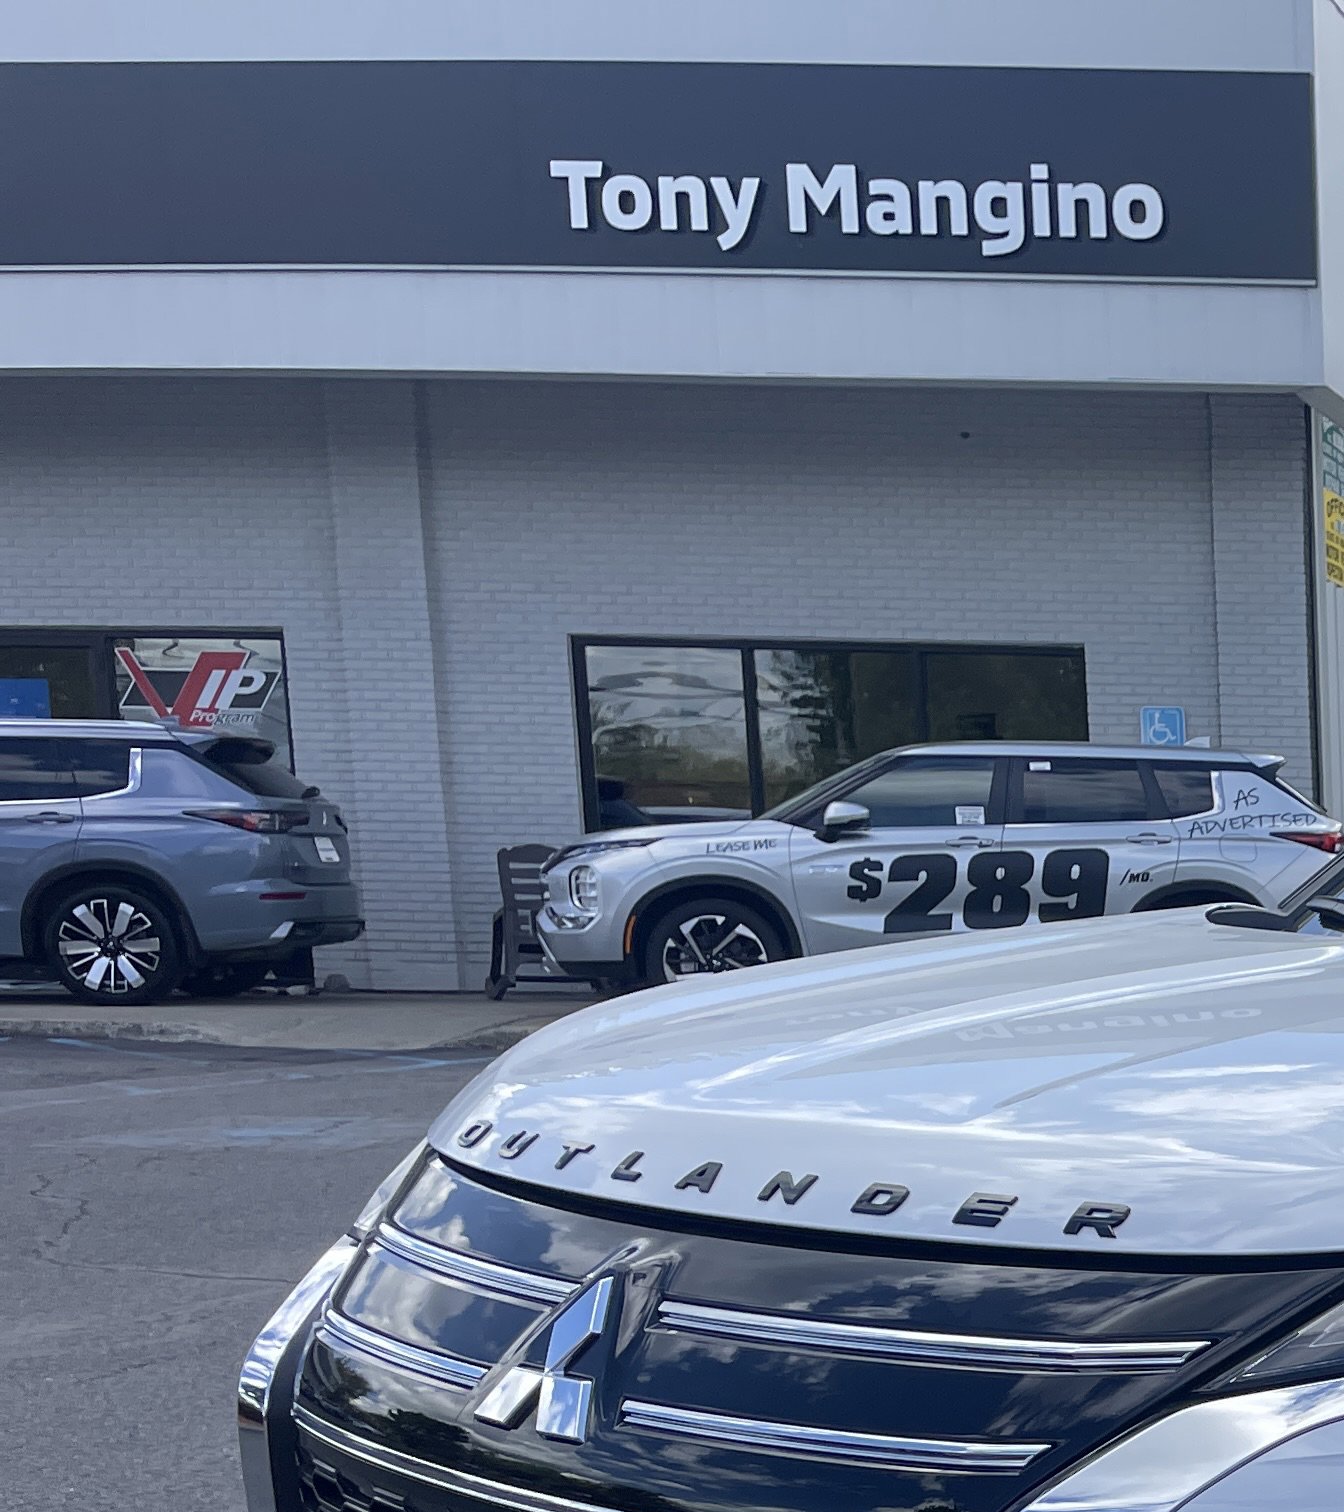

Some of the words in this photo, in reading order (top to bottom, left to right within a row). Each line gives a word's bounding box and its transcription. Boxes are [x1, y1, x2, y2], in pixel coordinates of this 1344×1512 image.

[549, 159, 760, 252] Tony
[785, 162, 1165, 257] Mangino
[114, 648, 267, 727] VIP
[189, 710, 256, 726] Program
[1233, 786, 1260, 811] AS
[705, 840, 750, 855] LEASE
[754, 838, 778, 851] ME
[1188, 812, 1317, 839] ADVERTISED
[846, 848, 1110, 934] $289
[456, 1118, 1132, 1239] OUTLANDER
